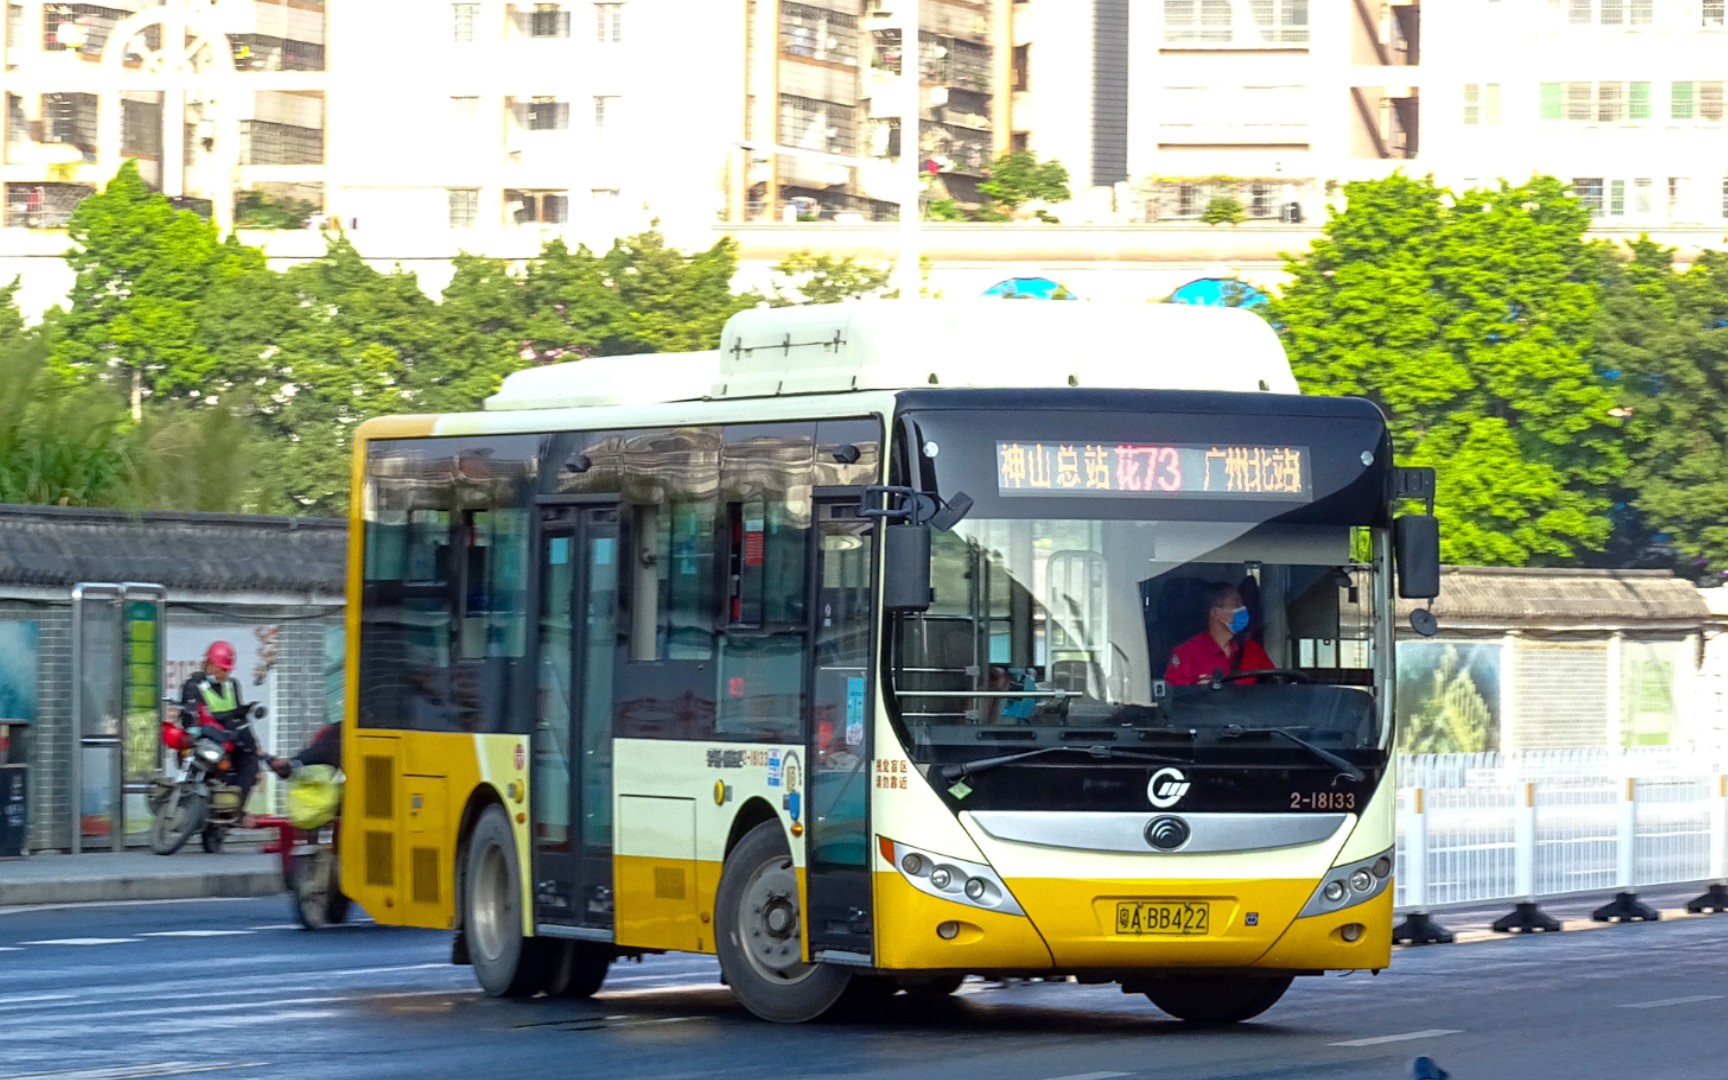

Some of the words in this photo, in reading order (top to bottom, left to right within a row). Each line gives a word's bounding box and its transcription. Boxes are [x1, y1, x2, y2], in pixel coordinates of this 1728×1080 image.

[1001, 443, 1110, 489] 神山总站
[1114, 444, 1182, 492] 花73
[1203, 446, 1302, 493] 广州北站
[1290, 792, 1356, 810] 2-18133
